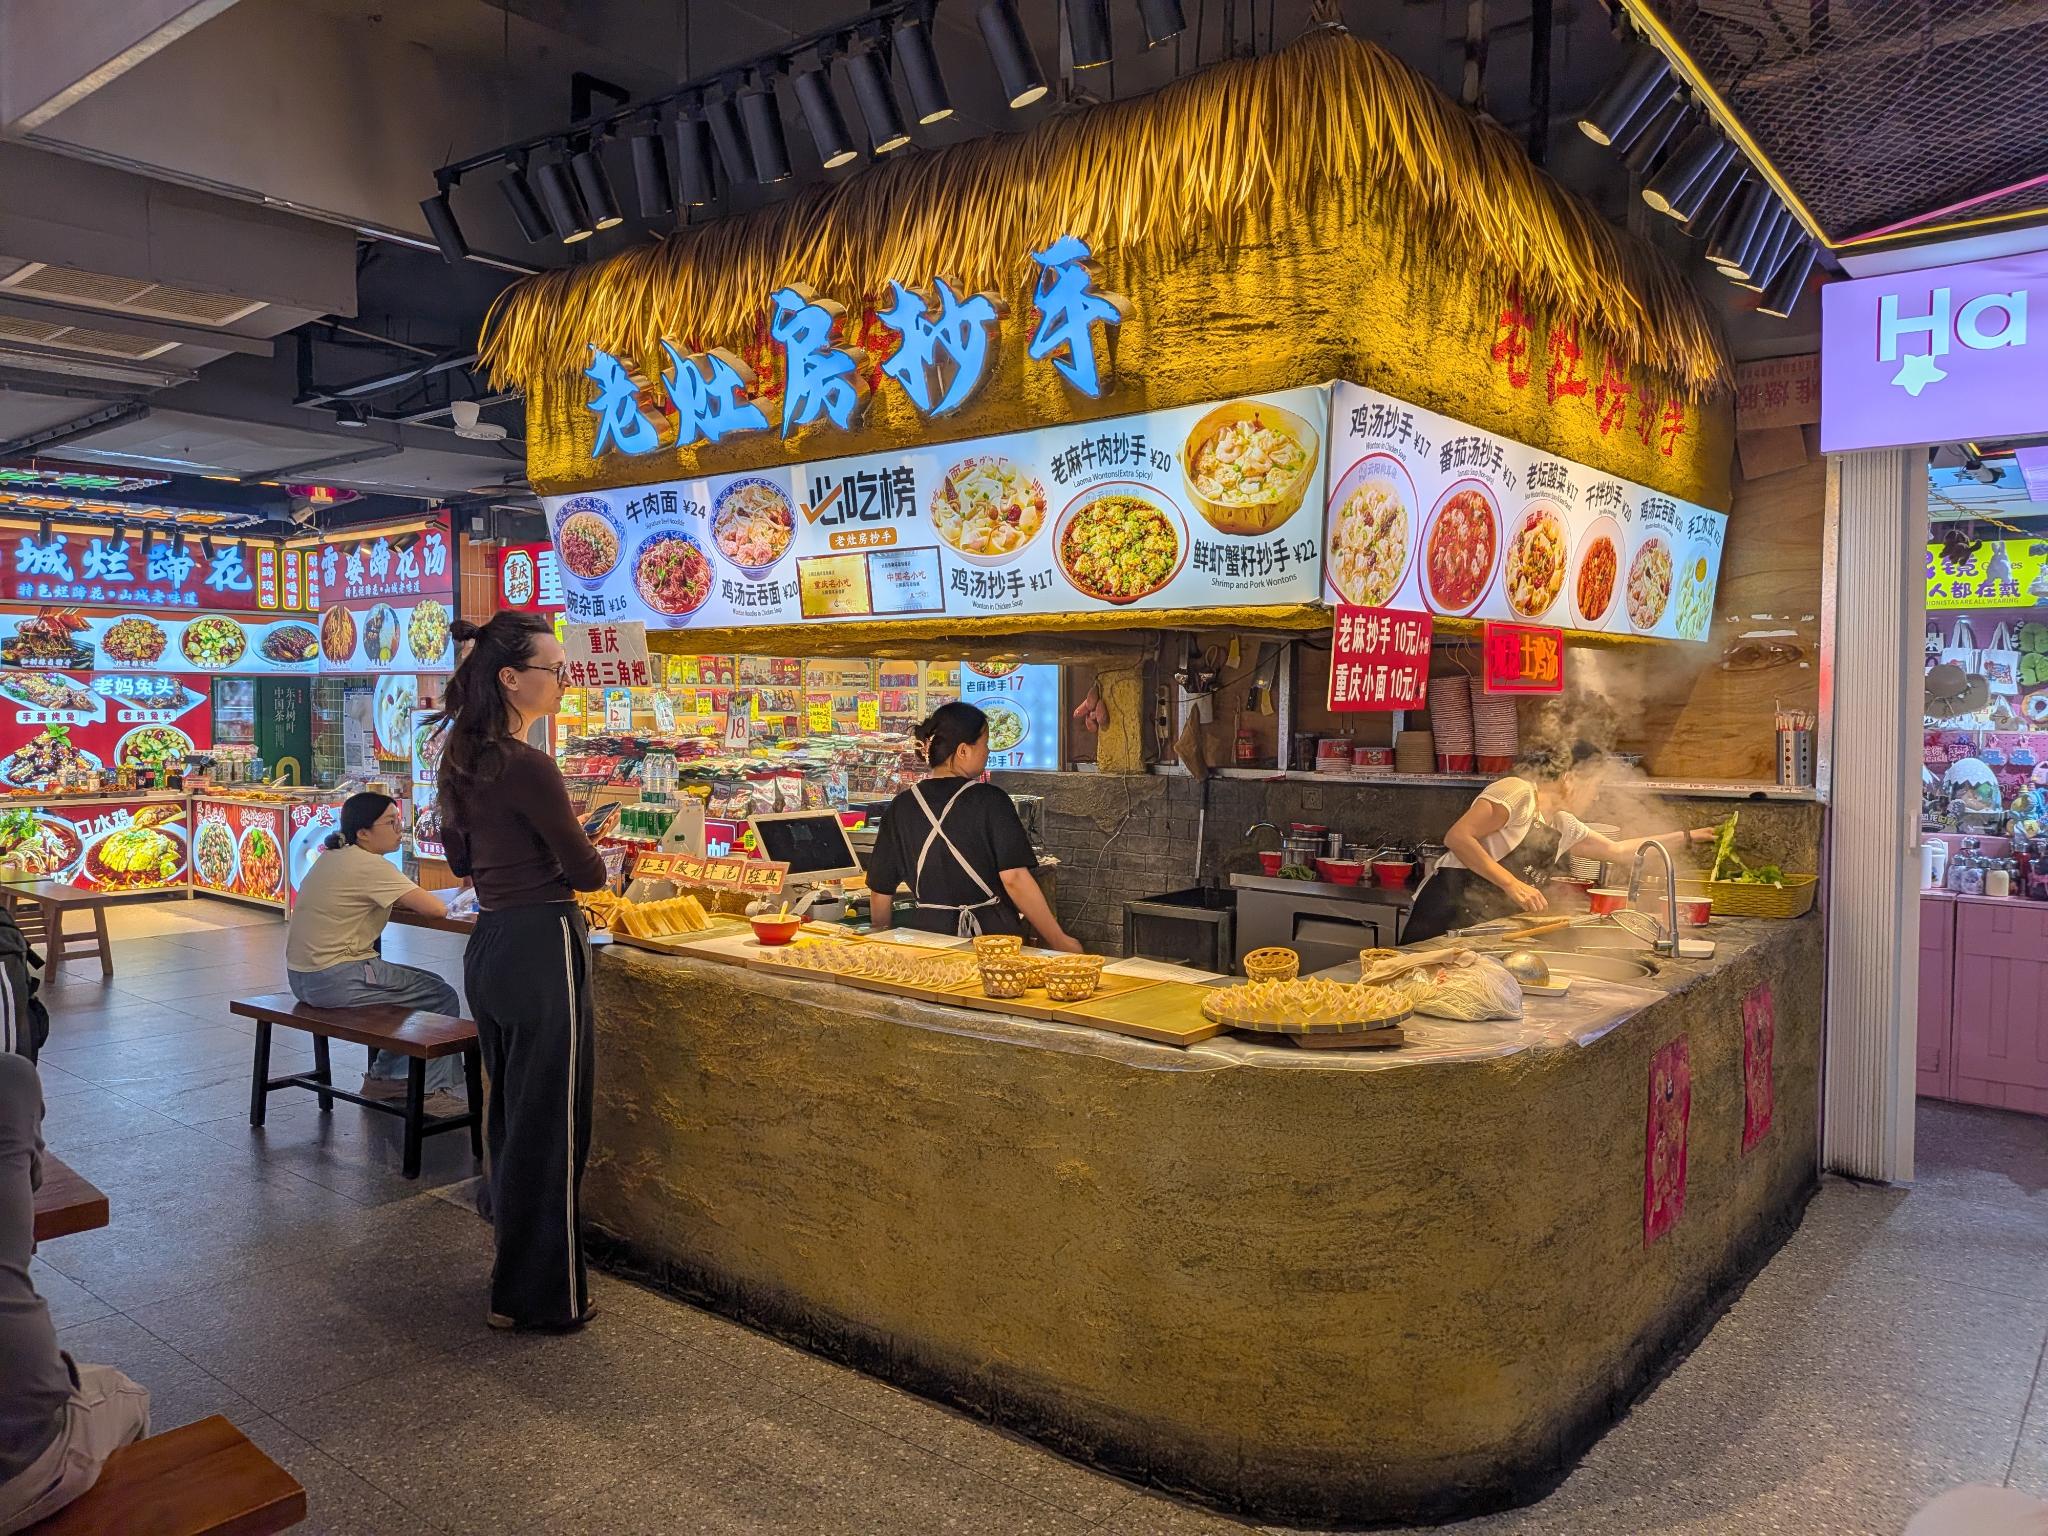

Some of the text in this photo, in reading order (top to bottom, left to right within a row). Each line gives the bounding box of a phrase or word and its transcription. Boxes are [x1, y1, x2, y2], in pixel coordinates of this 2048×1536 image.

[1876, 287, 2028, 361] Ha
[585, 234, 1121, 459] 老灶房抄手
[1349, 403, 1431, 459] 鸡汤抄手 ¥17
[1051, 432, 1147, 485] 老麻牛肉抄手
[1150, 447, 1171, 473] ¥20
[1440, 436, 1517, 492] 番茄汤抄手 ¥17
[1526, 461, 1569, 494] 老坛酸菜
[626, 490, 706, 524] 牛肉面 ¥24
[800, 466, 917, 526] 必吃榜
[1585, 481, 1624, 511] 干拌抄手
[835, 531, 893, 548] 老灶房抄手
[508, 558, 529, 582] 重庆
[1193, 537, 1318, 578] 鲜虾蟹籽抄手 ¥22
[508, 582, 530, 599] 老字号
[721, 578, 798, 607] 鸡汤云吞面 ¥20
[950, 567, 1053, 599] 鸡汤抄手 ¥17
[1211, 577, 1235, 590] Shrimp
[1235, 580, 1249, 589] and
[1249, 579, 1265, 589] Pork
[609, 594, 627, 613] ¥16
[1926, 599, 1960, 607] IONISTAS
[588, 626, 620, 654] 重庆
[1338, 613, 1392, 656] 老麻抄手
[94, 676, 175, 697] 老妈兔头
[569, 659, 649, 687] 特色三角粑
[967, 676, 1024, 693] 老麻抄手 17
[1334, 662, 1389, 702] 重庆小面
[1007, 751, 1024, 767] 17
[74, 808, 135, 839] 口水鸡
